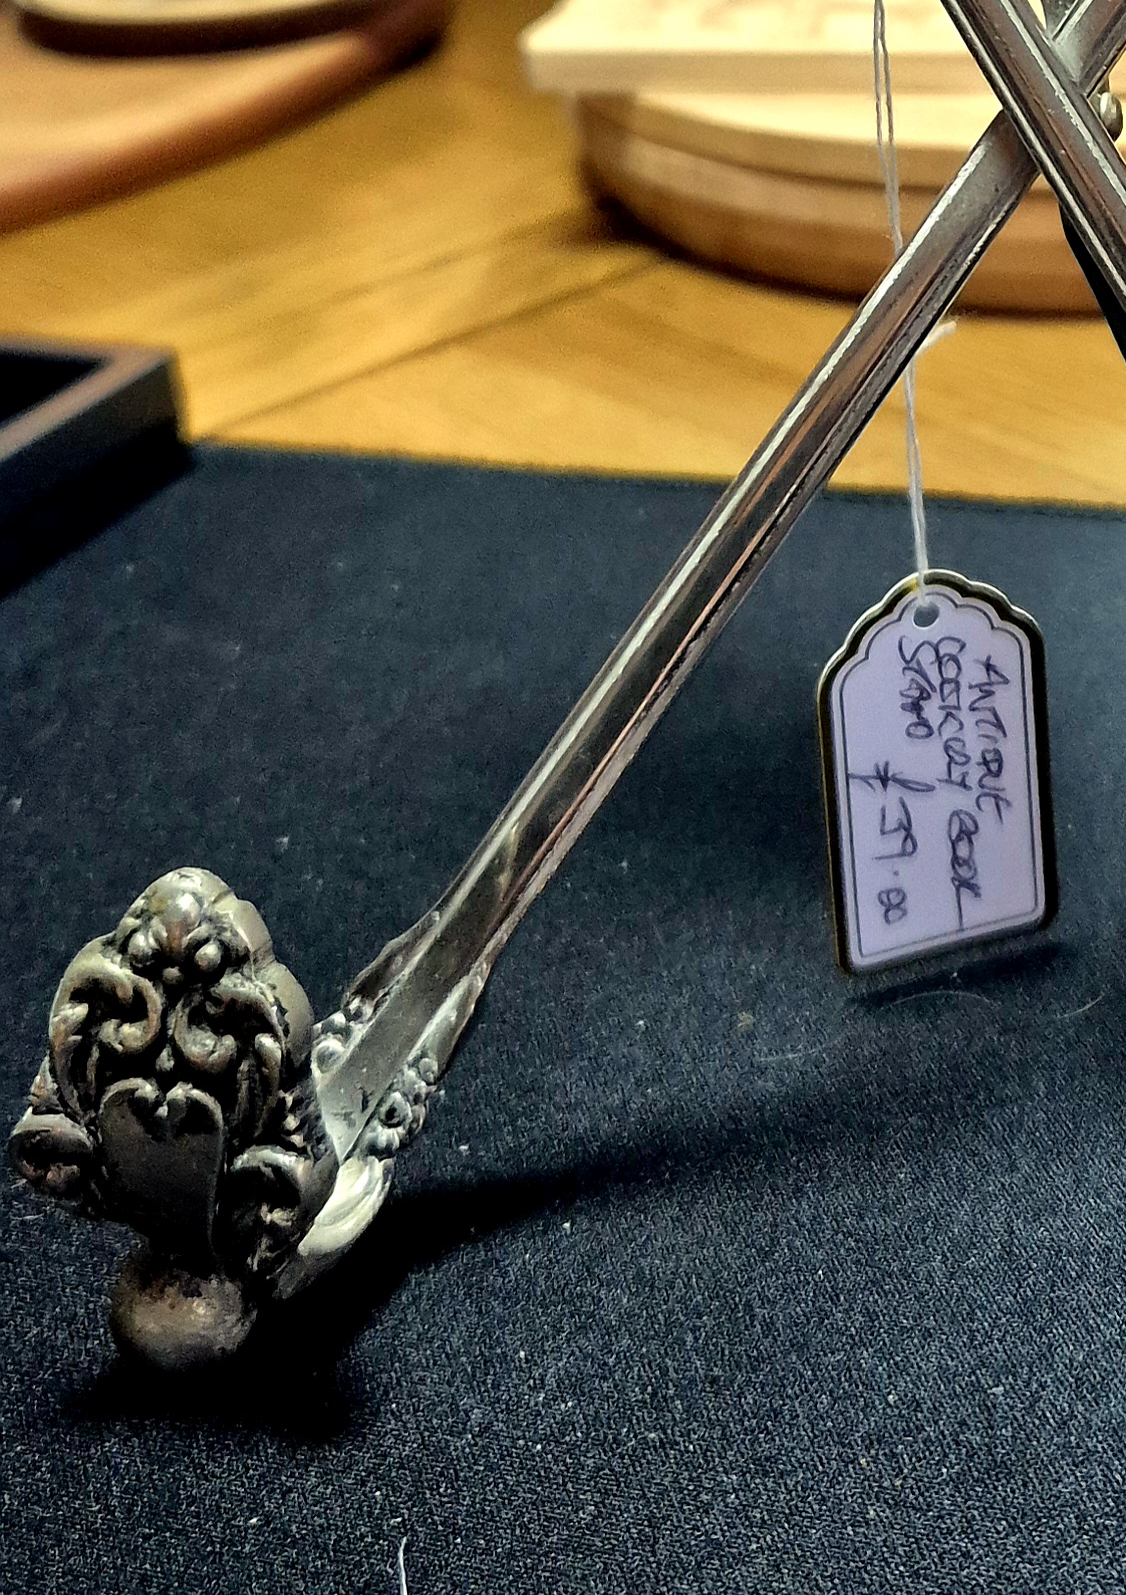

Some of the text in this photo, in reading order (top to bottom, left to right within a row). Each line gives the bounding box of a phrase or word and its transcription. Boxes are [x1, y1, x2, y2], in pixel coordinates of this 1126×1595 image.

[899, 635, 937, 739] STAND
[969, 655, 1010, 824] ANTIQUE
[948, 809, 981, 931] BOOK
